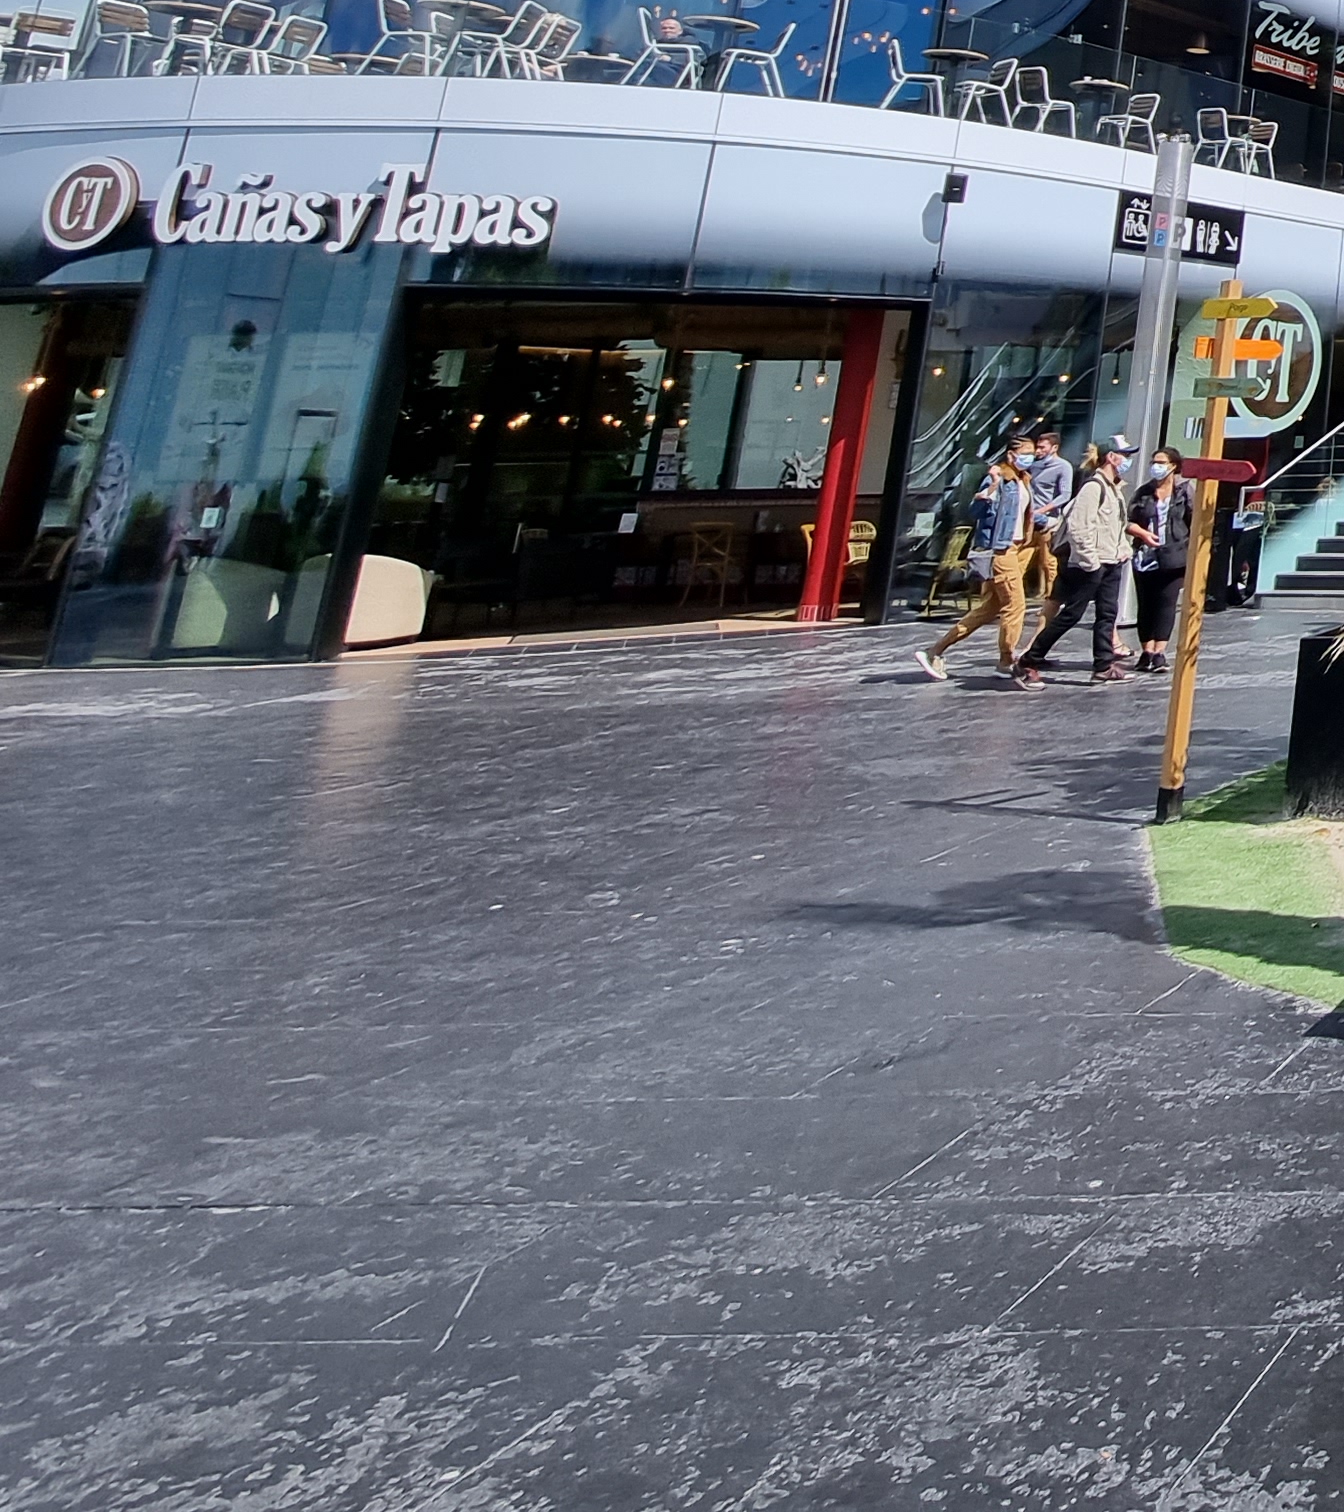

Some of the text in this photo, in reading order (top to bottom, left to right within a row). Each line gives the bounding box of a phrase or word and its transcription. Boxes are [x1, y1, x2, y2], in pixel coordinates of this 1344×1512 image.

[154, 162, 556, 255] Cañas y Tapas
